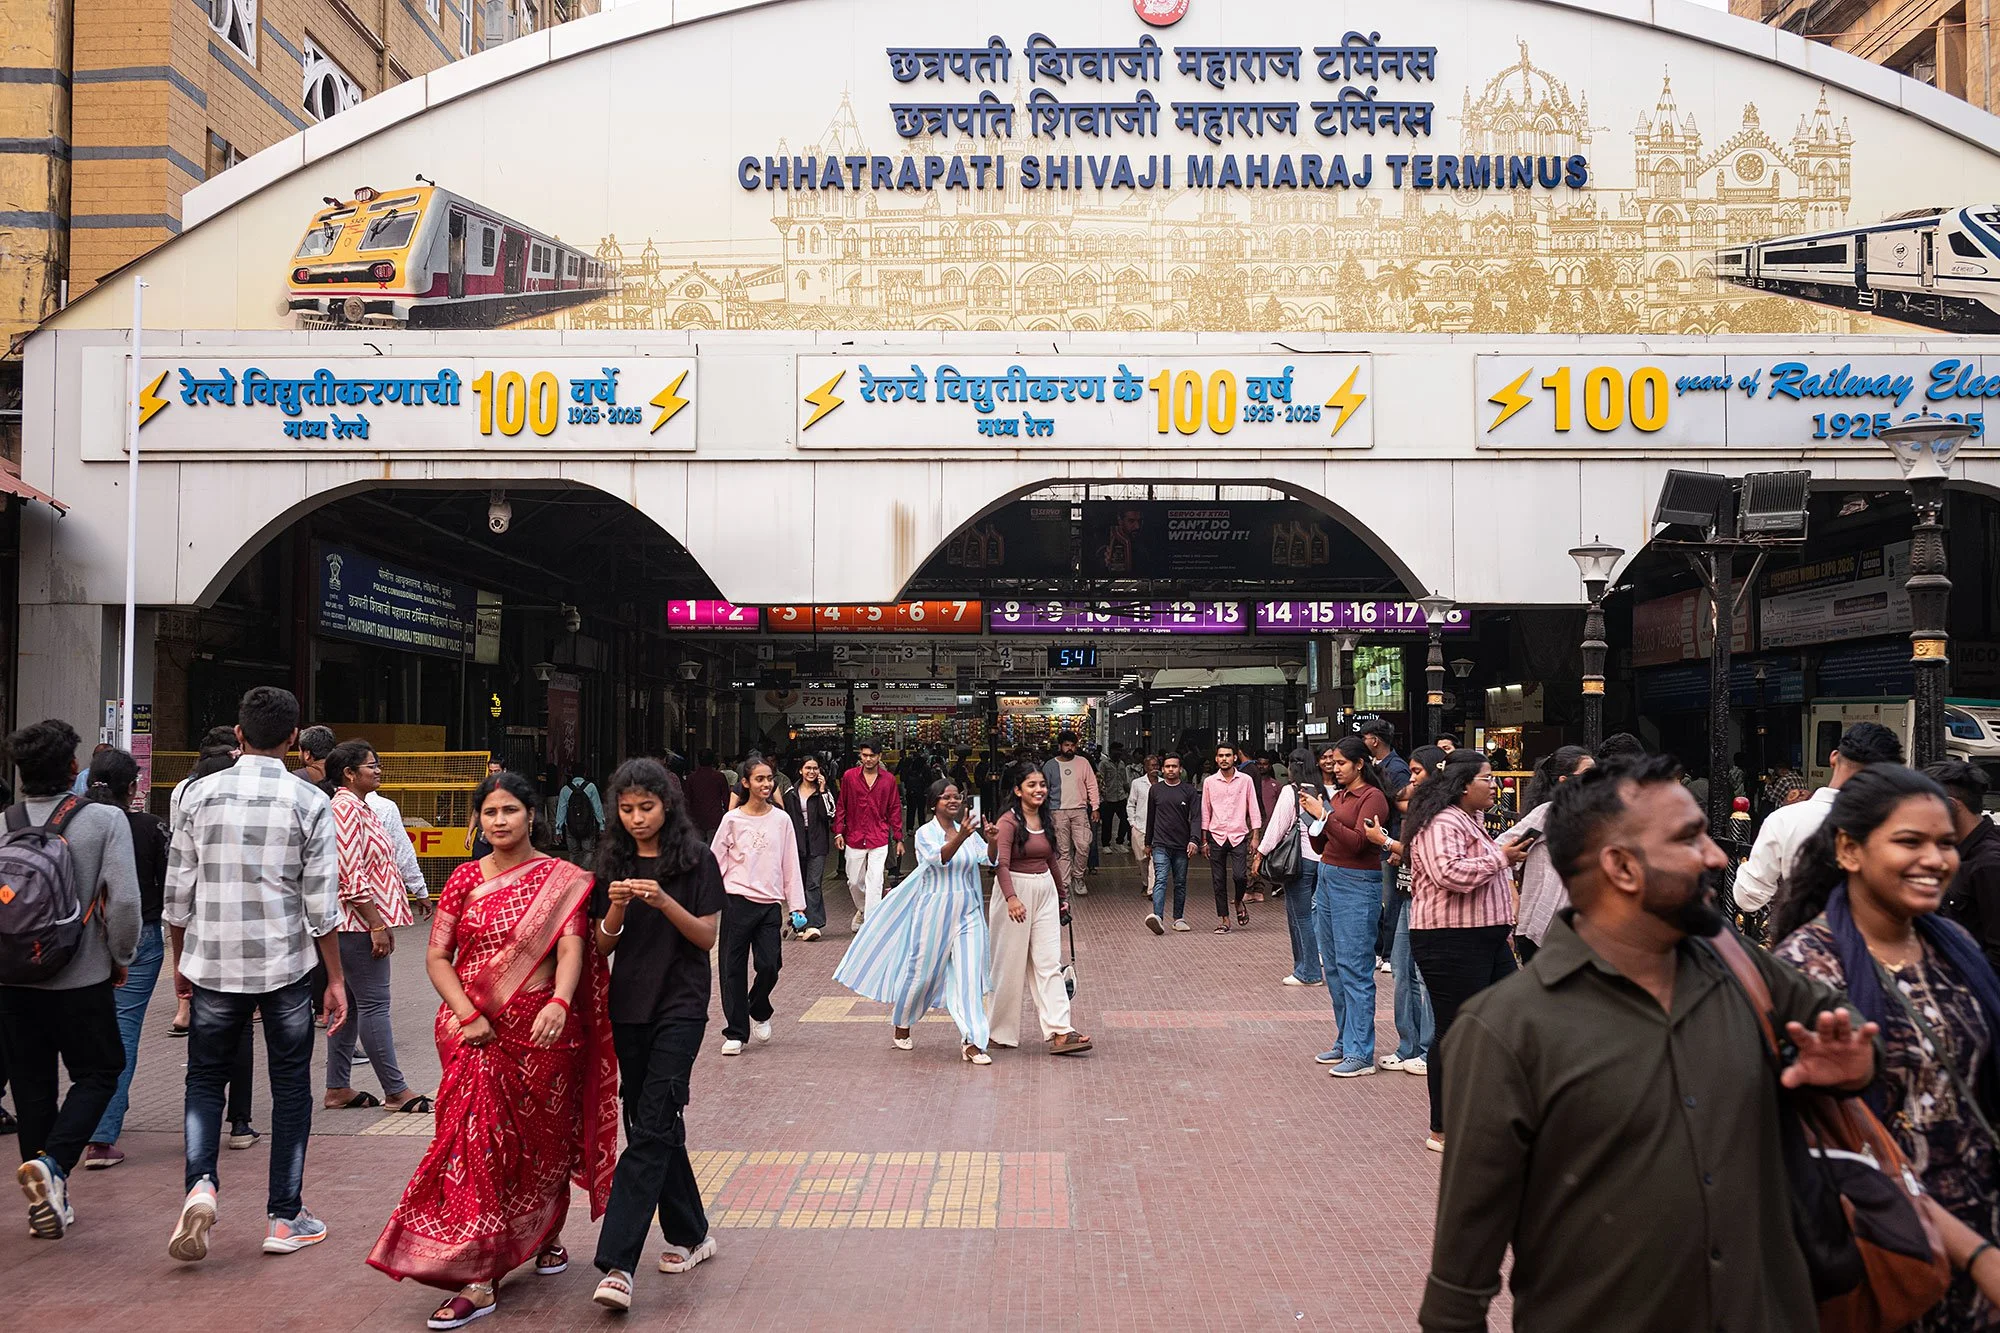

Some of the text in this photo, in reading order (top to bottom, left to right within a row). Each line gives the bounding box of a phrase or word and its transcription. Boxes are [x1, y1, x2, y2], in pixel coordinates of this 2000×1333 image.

[887, 31, 1437, 88] छत्रपती शिवाजी महाराज टर्मिनस
[890, 86, 1434, 143] छत्रपति शिवाजी महाराज टर्मिनस
[738, 154, 1588, 191] CHHATRAPATI SHIVAJI MAHARAJ TERMINUS
[179, 367, 618, 435] रेल्वे विद्युतीकरणाची 100 वर्षे
[860, 364, 1295, 434] रेलवे विद्युतीकरण के 100 वर्ष
[1542, 366, 1670, 431] 100
[1676, 374, 1733, 397] years
[1739, 368, 1762, 398] of
[1769, 361, 1914, 407] Railway
[283, 412, 369, 440] मध्य रेल्वे
[977, 411, 1055, 438] मध्य रेल
[1168, 519, 1231, 530] CAN'T DO
[1168, 530, 1251, 541] WITHOUT IT!
[1800, 562, 1821, 583] WORLD
[373, 582, 388, 594] POLICE
[686, 600, 744, 621] 1 2
[823, 606, 841, 621] 4
[910, 600, 925, 622] 6
[953, 600, 968, 622] 7
[1004, 600, 1021, 622] 8
[1170, 601, 1197, 623] 12
[1213, 601, 1240, 623] 13
[1265, 601, 1293, 623] 14
[1308, 601, 1335, 623] 15
[1351, 601, 1378, 623] 16
[1393, 601, 1420, 623] 17
[347, 616, 377, 637] CHHATRAPATI
[377, 622, 394, 641] SHIVAJI
[394, 626, 413, 643] MAHARAJ
[413, 630, 432, 647] TERMINUS
[448, 637, 460, 652] POLICE
[761, 646, 768, 658] 1
[836, 646, 846, 658] 2
[904, 647, 913, 658] 3
[1001, 647, 1010, 658] 4
[1059, 648, 1096, 667] 5:41
[803, 696, 824, 707] ₹25
